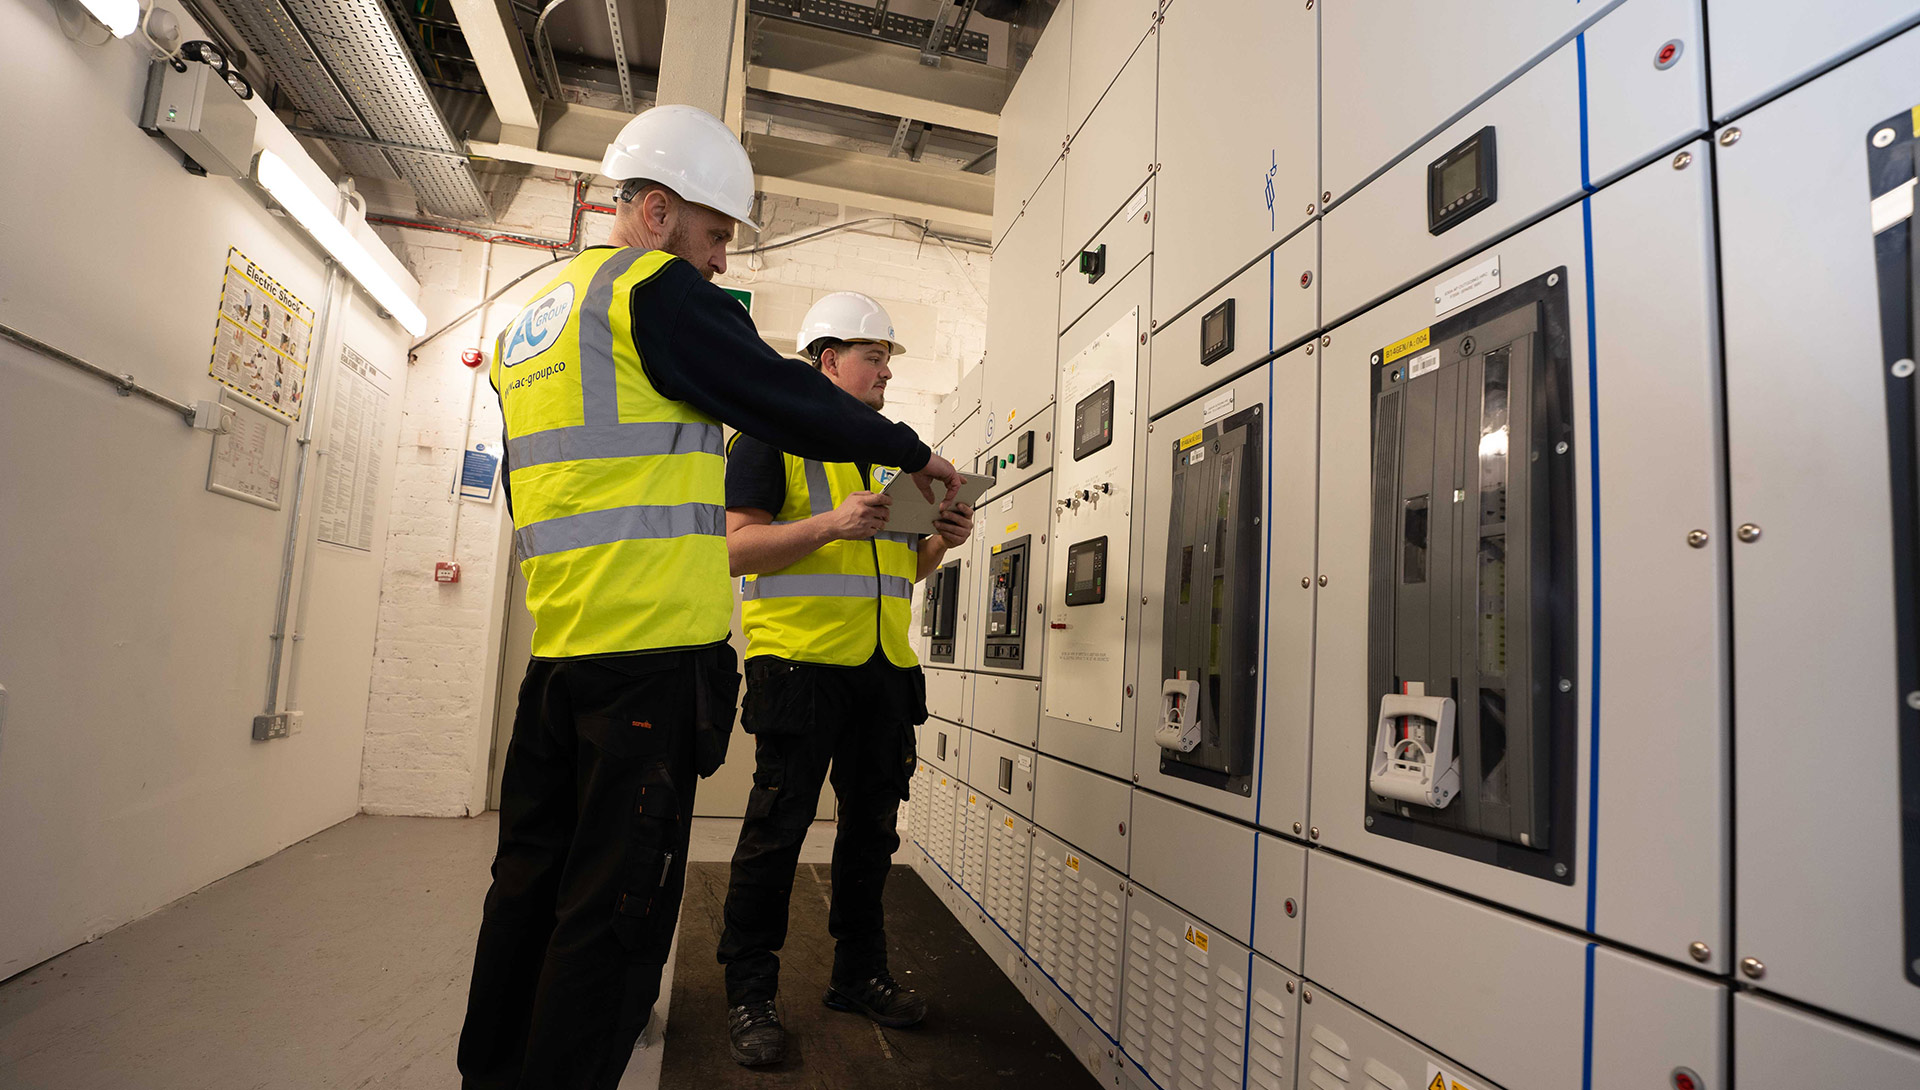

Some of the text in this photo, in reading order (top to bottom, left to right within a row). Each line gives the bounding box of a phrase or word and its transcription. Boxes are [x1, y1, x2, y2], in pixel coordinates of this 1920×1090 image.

[246, 264, 301, 315] Electric Shock
[535, 302, 569, 327] GROUP
[506, 297, 556, 360] AC
